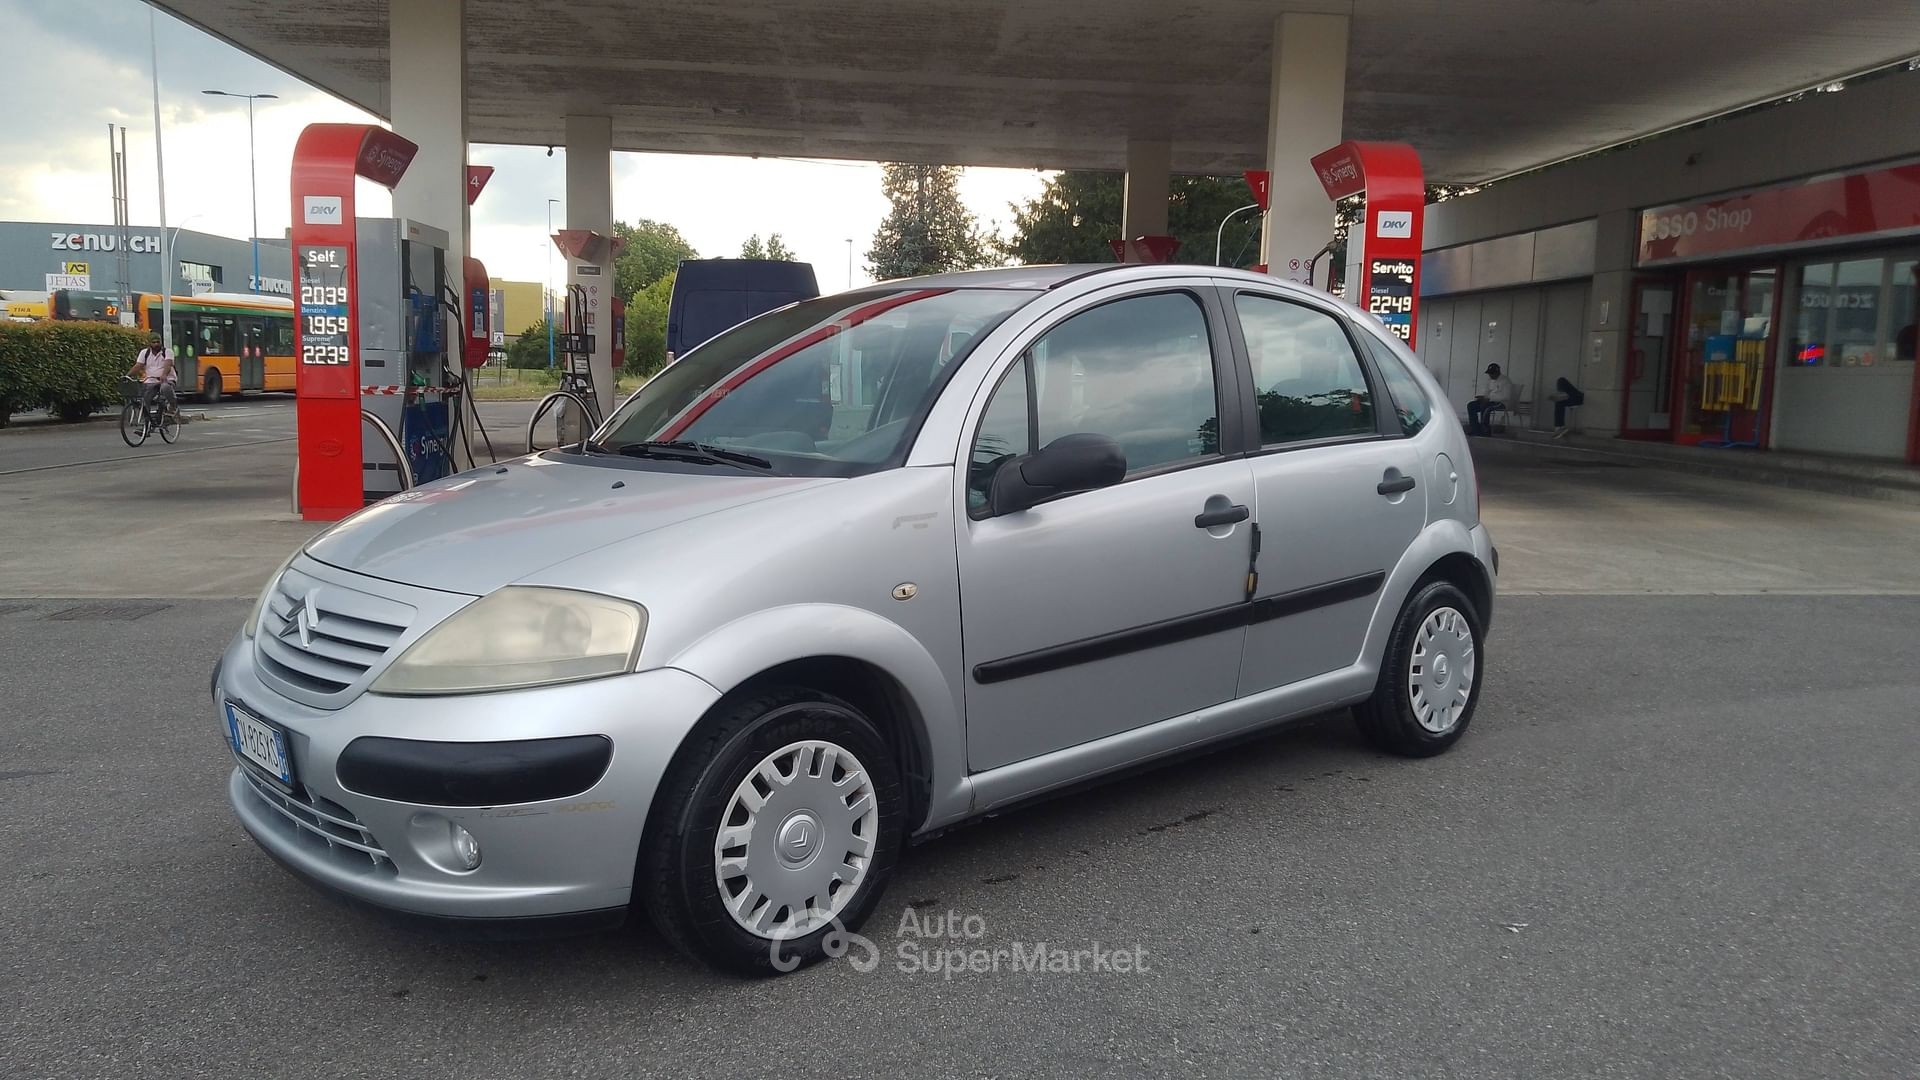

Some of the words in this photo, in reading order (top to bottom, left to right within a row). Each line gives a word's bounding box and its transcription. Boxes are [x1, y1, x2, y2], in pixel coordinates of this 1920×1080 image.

[1330, 163, 1358, 182] Synergy
[470, 176, 480, 187] 4
[1258, 181, 1265, 193] 1
[310, 206, 337, 215] DKV
[1382, 220, 1407, 229] DKV
[1704, 207, 1752, 232] Shop
[308, 250, 336, 262] Self
[1372, 262, 1414, 274] Servito
[106, 305, 118, 316] 27
[301, 306, 327, 314] Benzina
